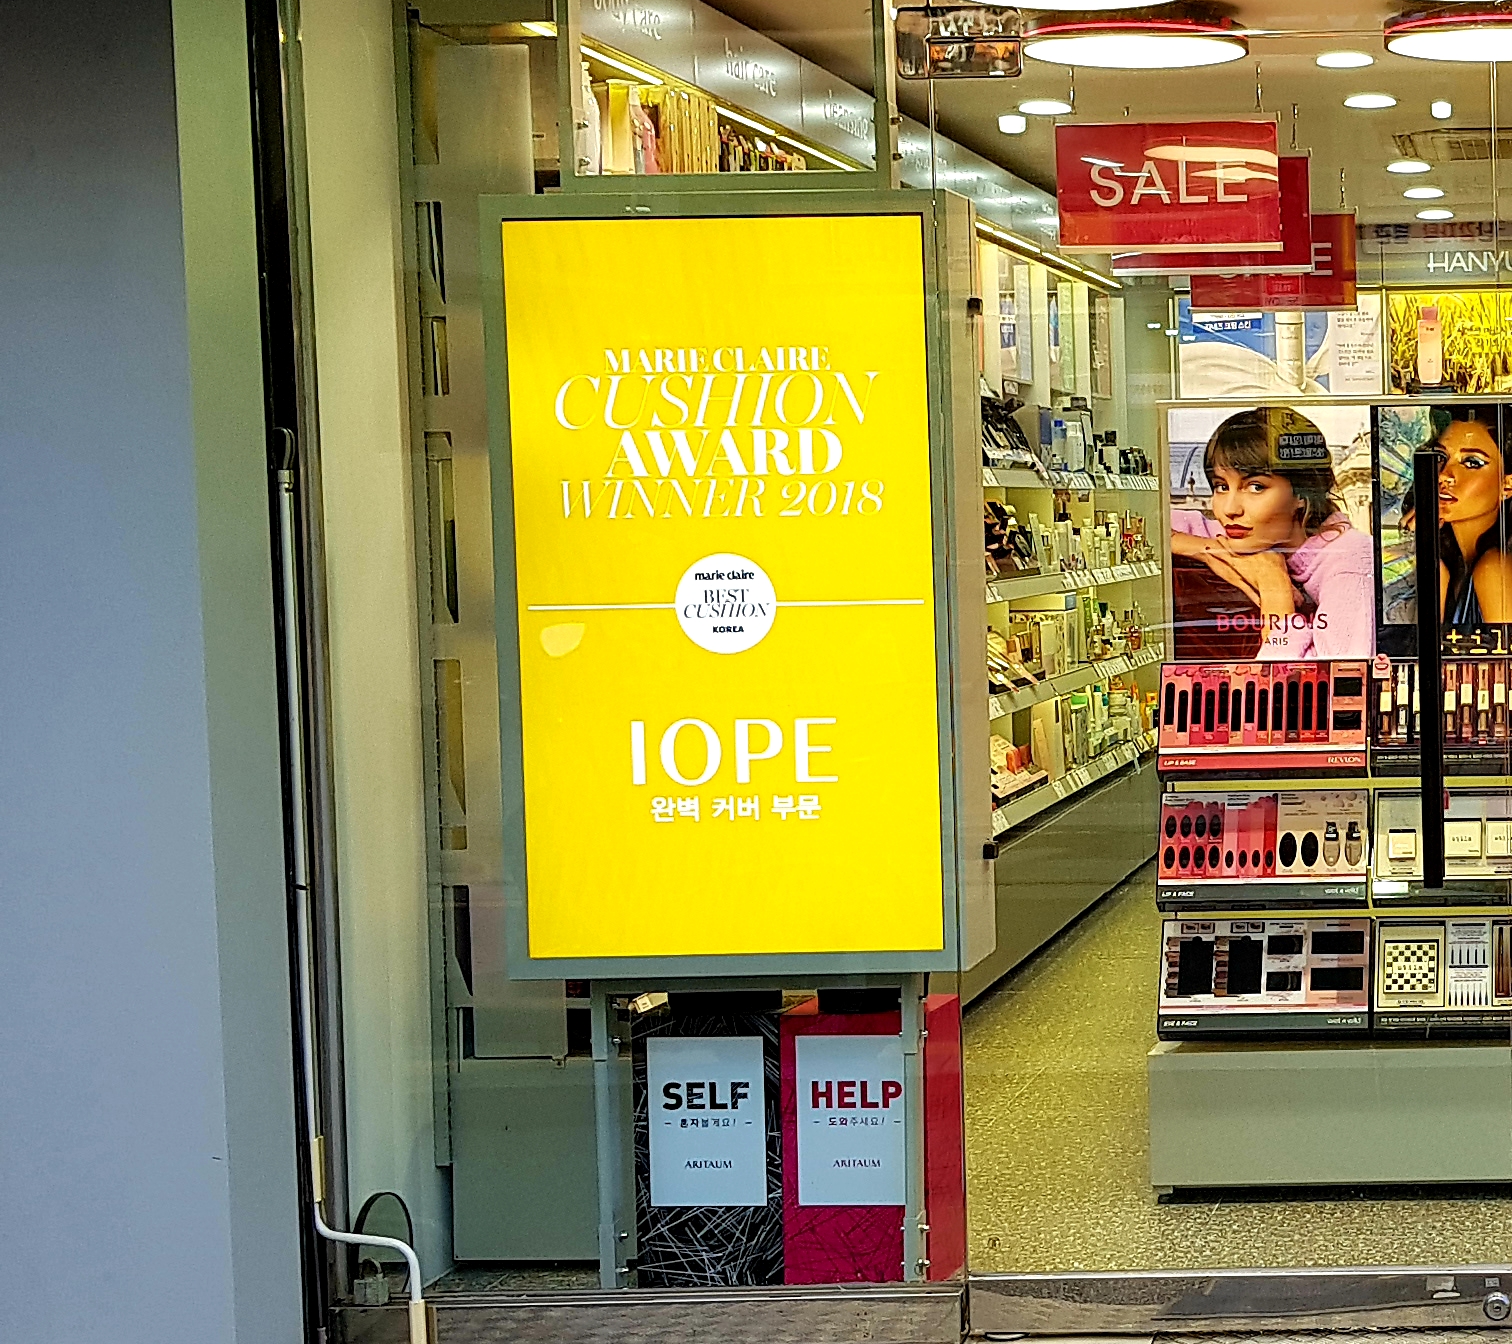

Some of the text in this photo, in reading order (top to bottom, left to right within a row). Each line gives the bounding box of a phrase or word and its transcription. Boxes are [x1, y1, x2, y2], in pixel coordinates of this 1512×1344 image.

[1090, 159, 1249, 208] SALE
[603, 346, 831, 373] MARIE CLAIRE
[554, 370, 883, 430] CUSHION
[604, 427, 843, 478] AWARD
[560, 477, 885, 519] WINNER 2018
[694, 569, 755, 582] marie claire
[703, 588, 750, 604] BEST
[683, 602, 770, 620] CUSHION
[1216, 612, 1329, 634] BOURJOIS
[711, 625, 745, 634] KOREA
[1264, 636, 1289, 646] ARIS
[631, 717, 839, 787] IOPE
[1327, 756, 1362, 764] REVLON
[650, 794, 822, 823] 완벽 커버 부문
[662, 1081, 750, 1111] SELF
[811, 1080, 902, 1109] HELP
[684, 1159, 733, 1169] ARITAUM
[833, 1158, 881, 1168] ARITAUM
